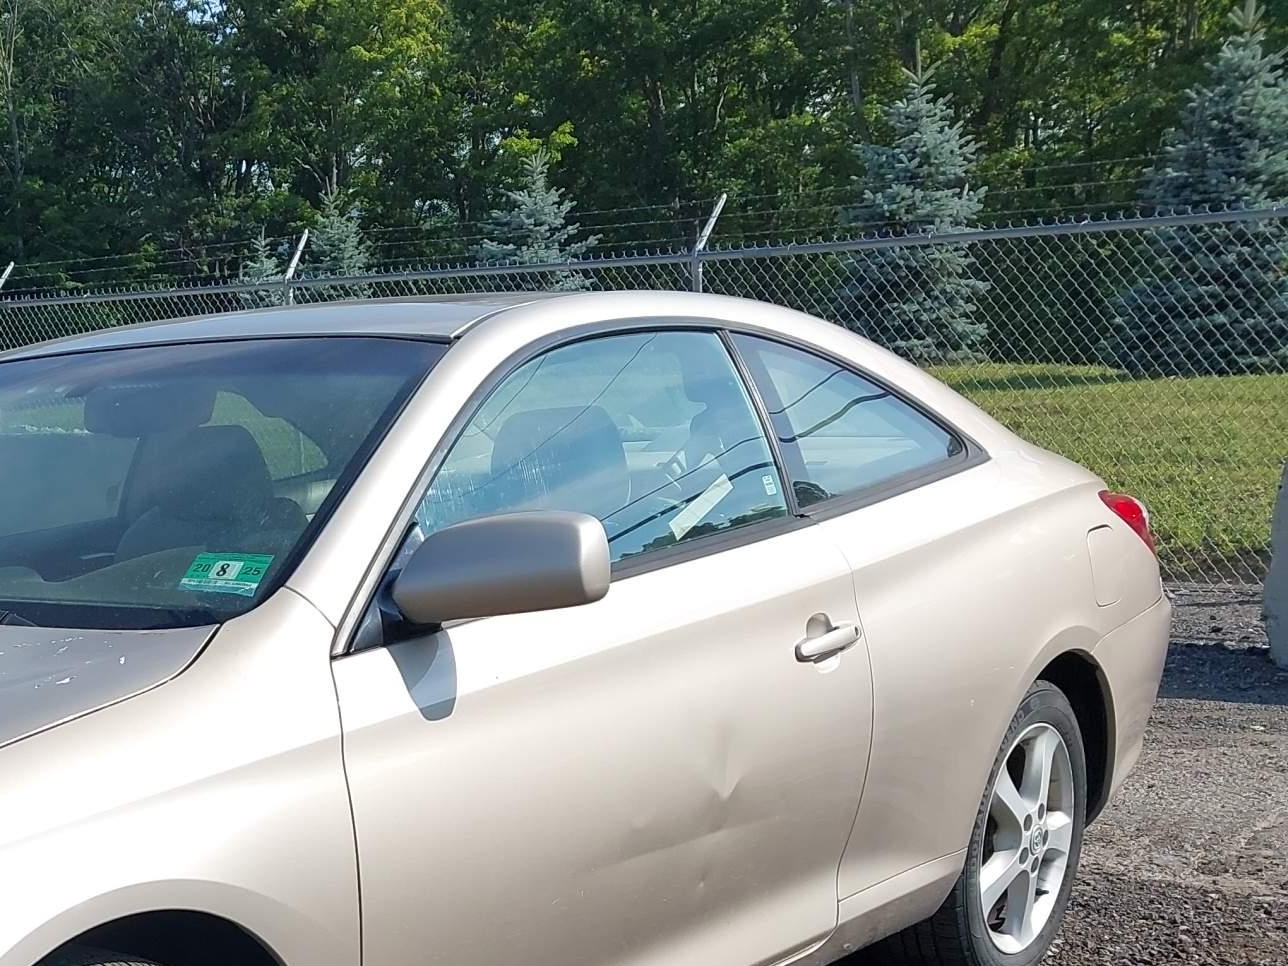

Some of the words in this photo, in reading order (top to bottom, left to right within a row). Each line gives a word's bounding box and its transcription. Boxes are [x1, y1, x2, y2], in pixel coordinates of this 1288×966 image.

[192, 563, 212, 573] 20
[215, 563, 231, 577] 8
[242, 566, 262, 576] 25
